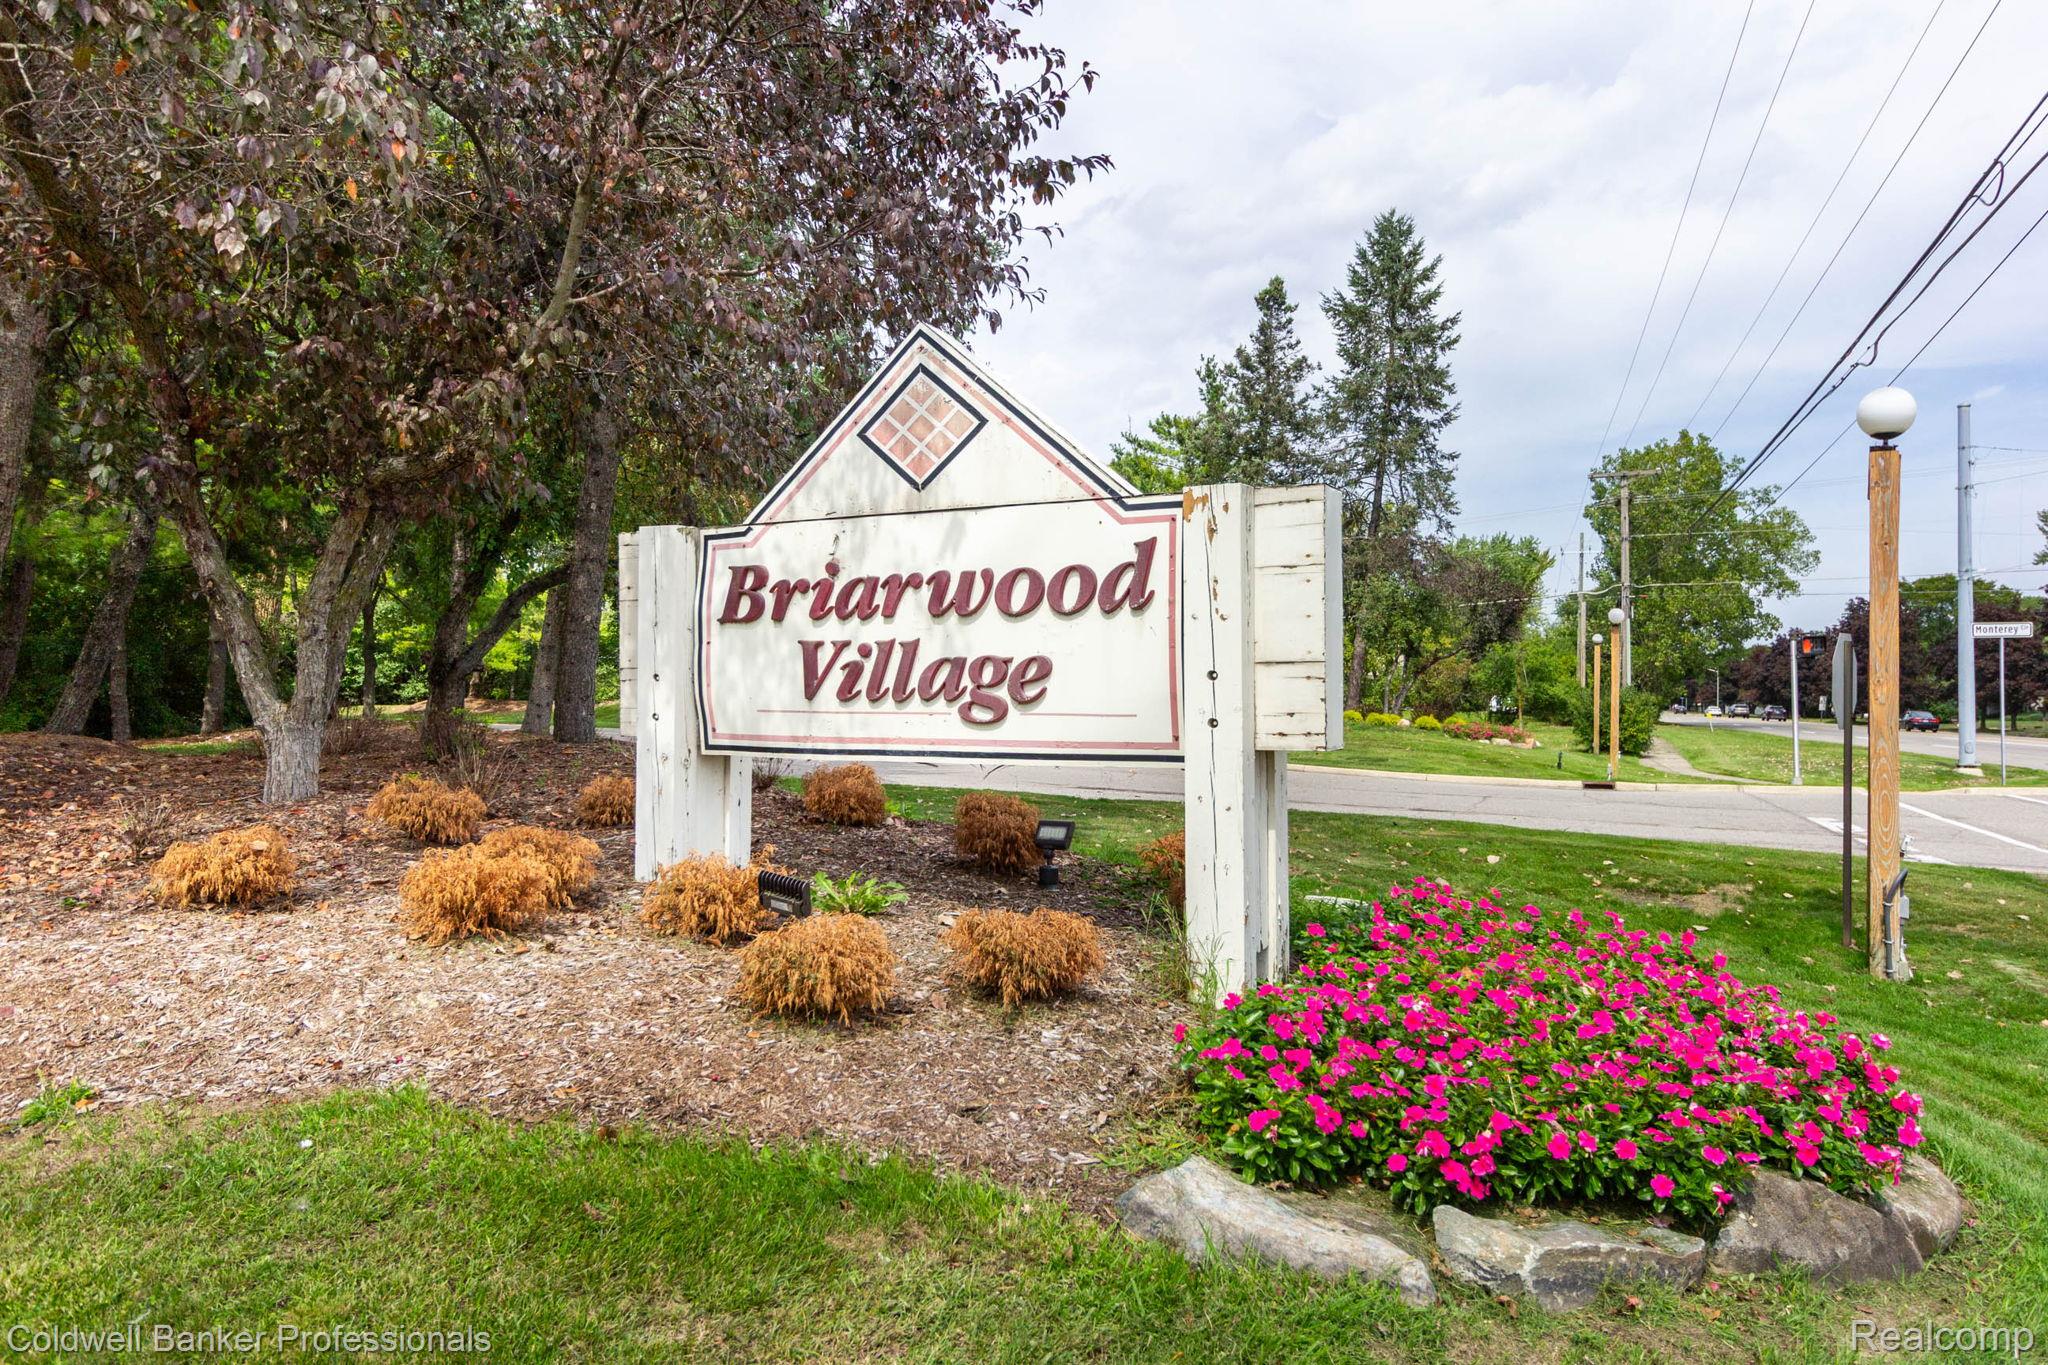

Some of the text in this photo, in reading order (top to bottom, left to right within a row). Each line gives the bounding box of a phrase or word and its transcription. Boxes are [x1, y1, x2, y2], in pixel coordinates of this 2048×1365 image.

[718, 536, 1158, 624] Briarwood
[1975, 625, 2018, 635] Monterey
[797, 637, 1054, 725] Village
